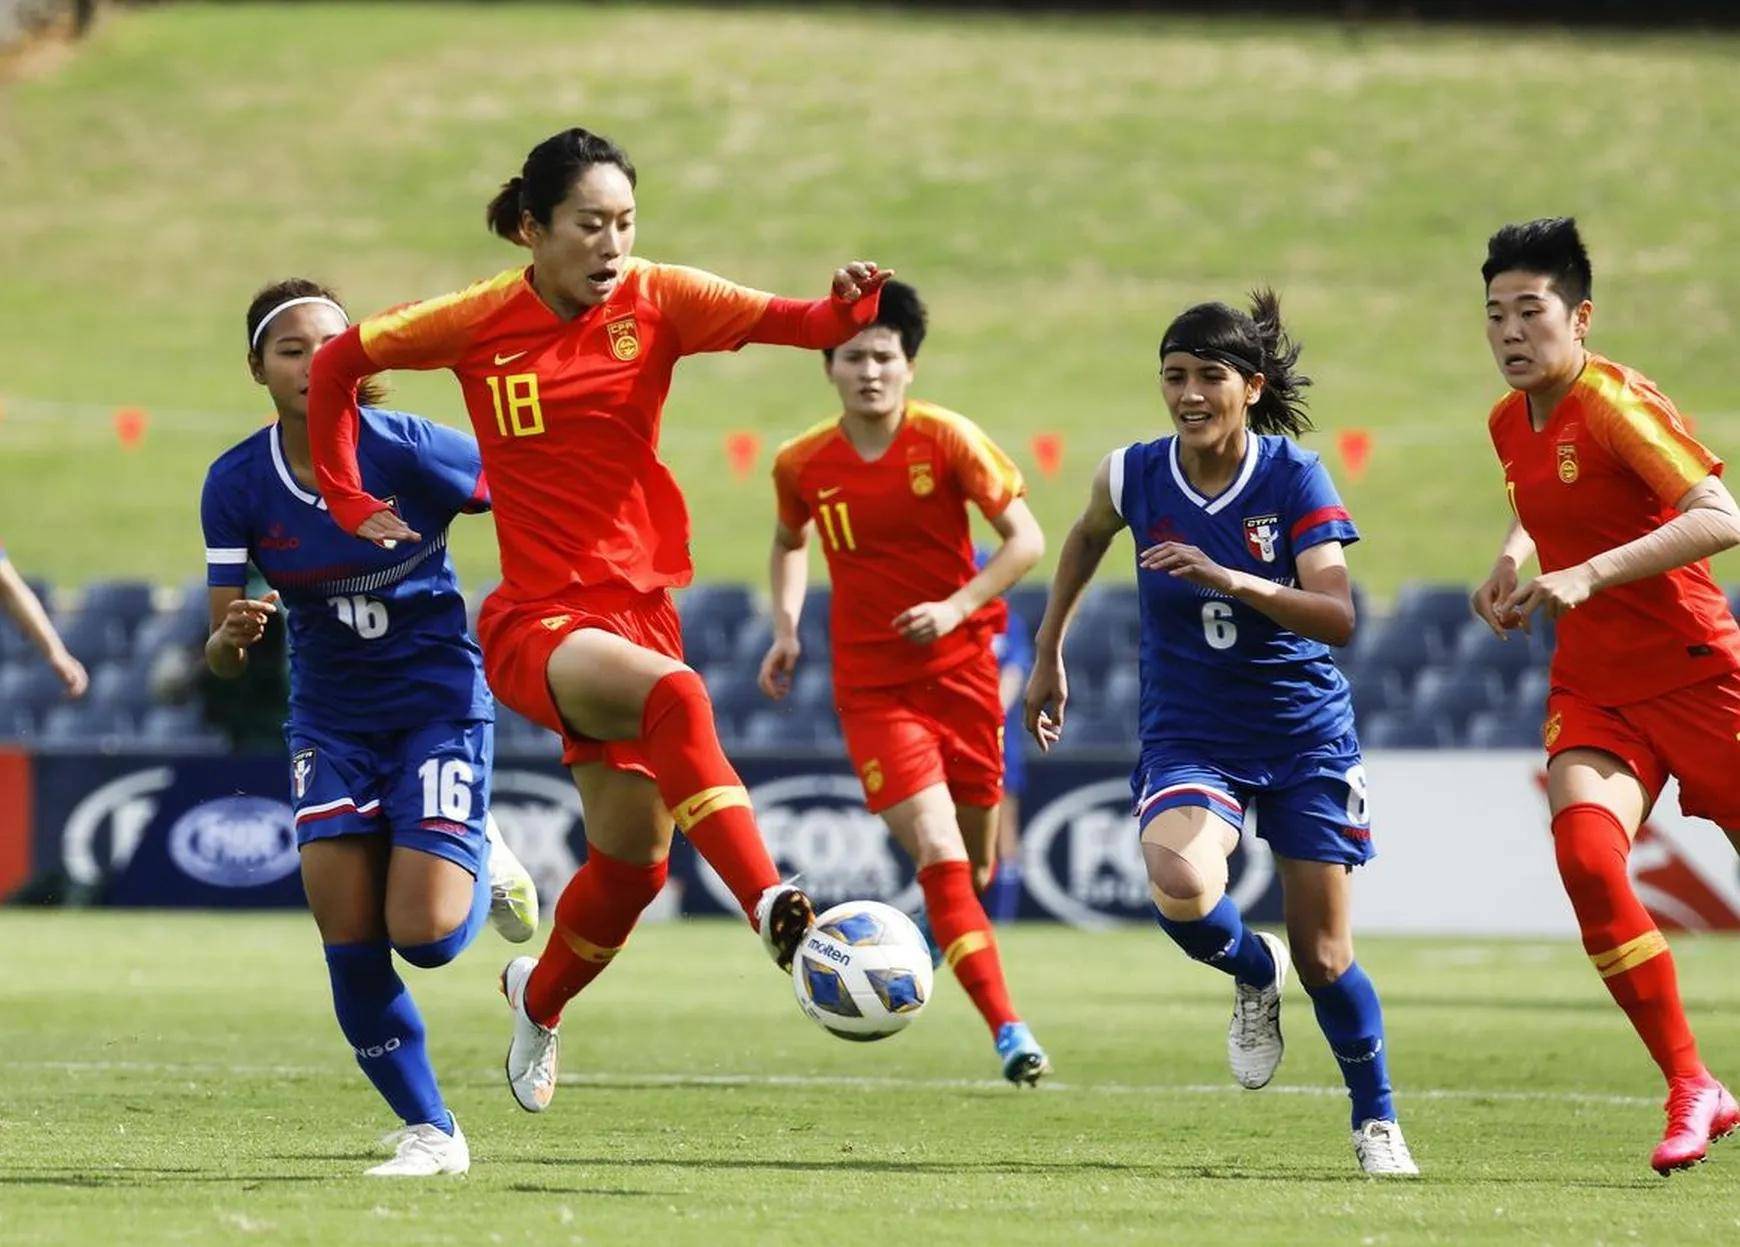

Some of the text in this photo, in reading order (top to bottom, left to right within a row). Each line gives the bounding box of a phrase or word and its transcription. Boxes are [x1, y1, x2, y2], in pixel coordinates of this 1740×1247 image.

[486, 373, 545, 436] 18
[819, 502, 856, 551] 11
[326, 595, 388, 639] 16
[1202, 601, 1238, 650] 6
[418, 757, 473, 822] 16
[808, 938, 851, 966] molten
